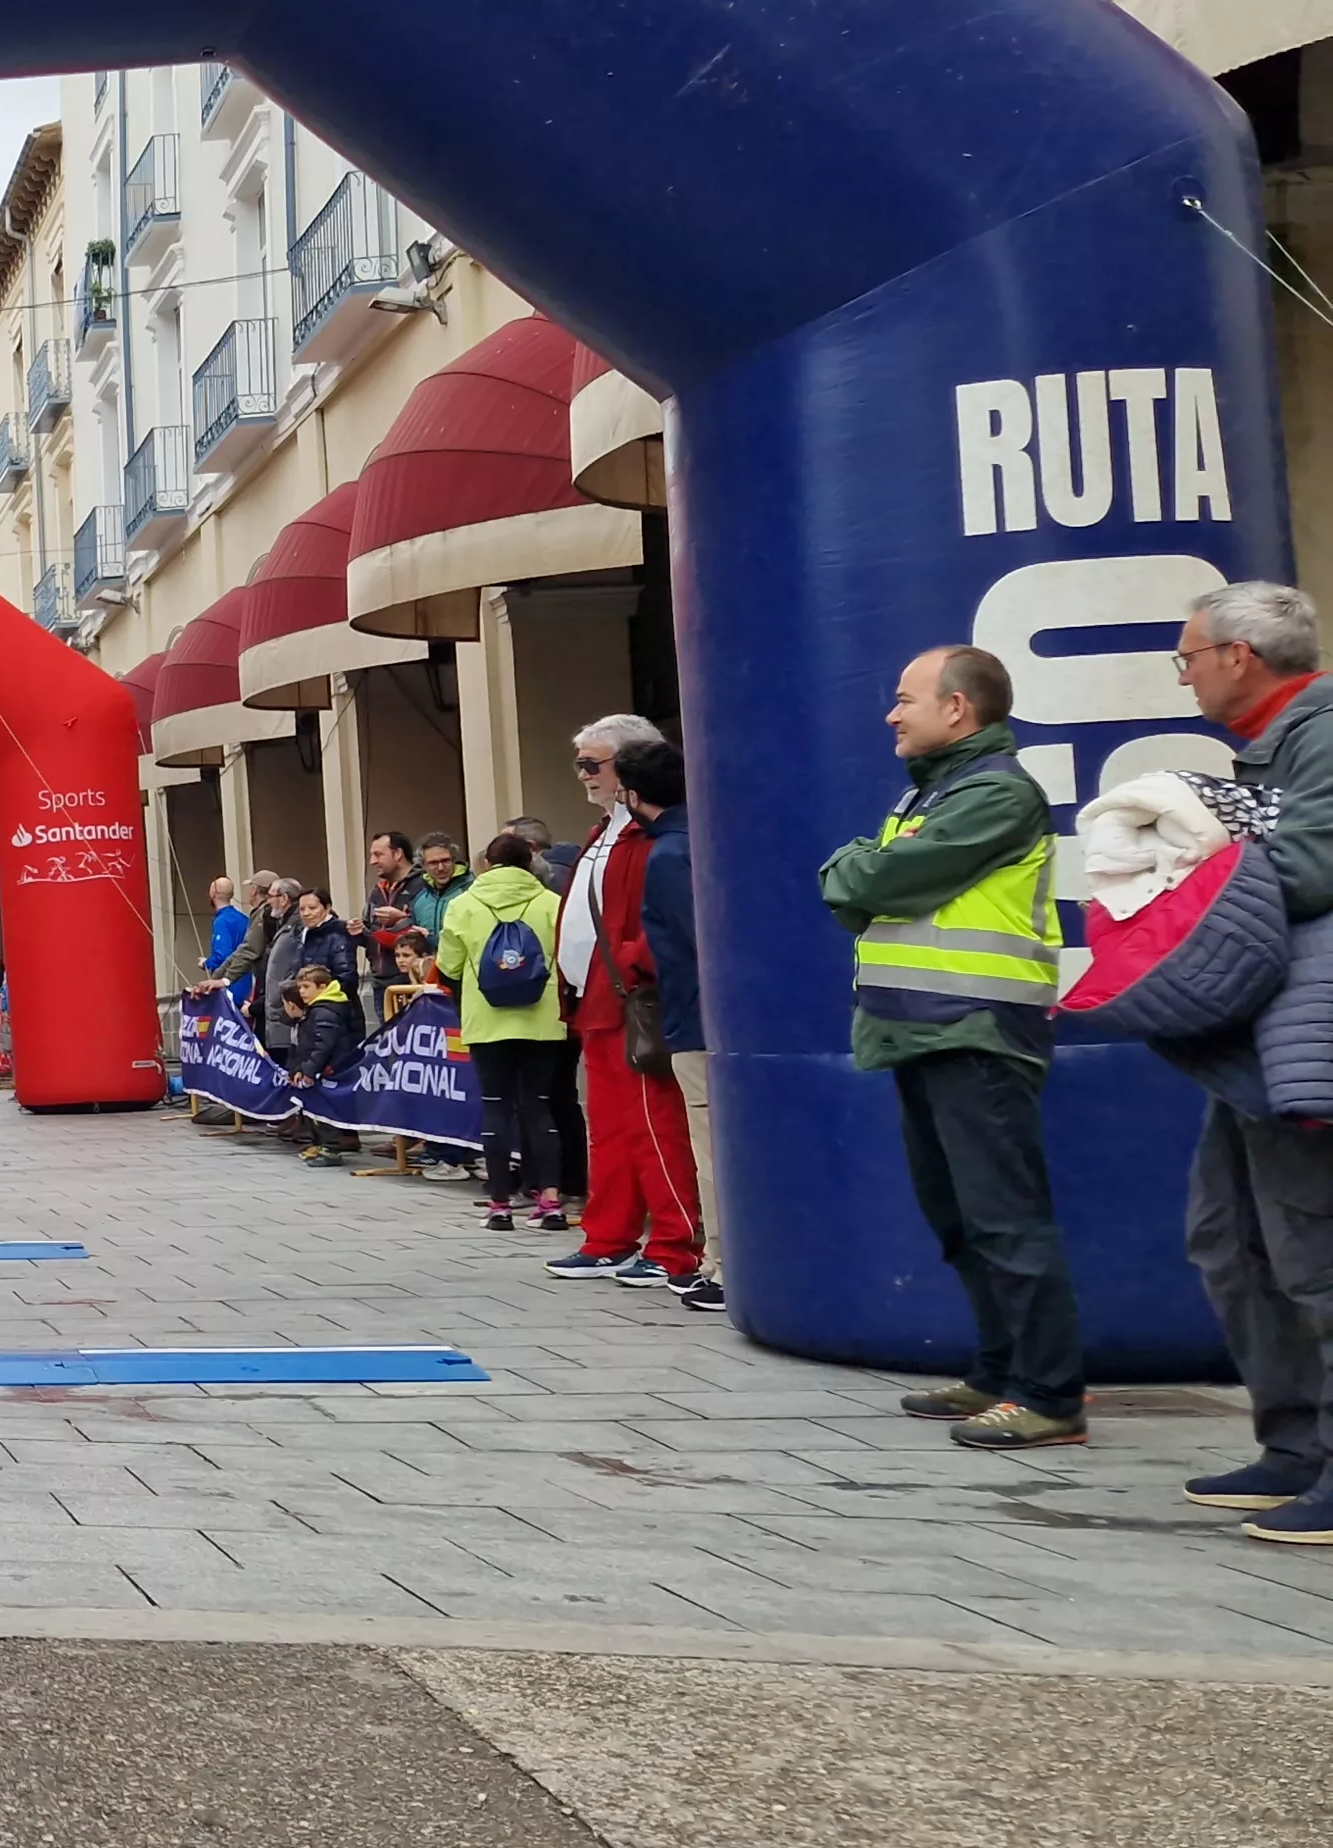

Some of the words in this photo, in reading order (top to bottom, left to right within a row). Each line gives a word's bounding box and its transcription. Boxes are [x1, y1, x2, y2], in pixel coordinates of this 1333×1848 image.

[955, 368, 1232, 537] RUTA
[38, 789, 105, 813] Sports
[35, 822, 134, 844] Santander
